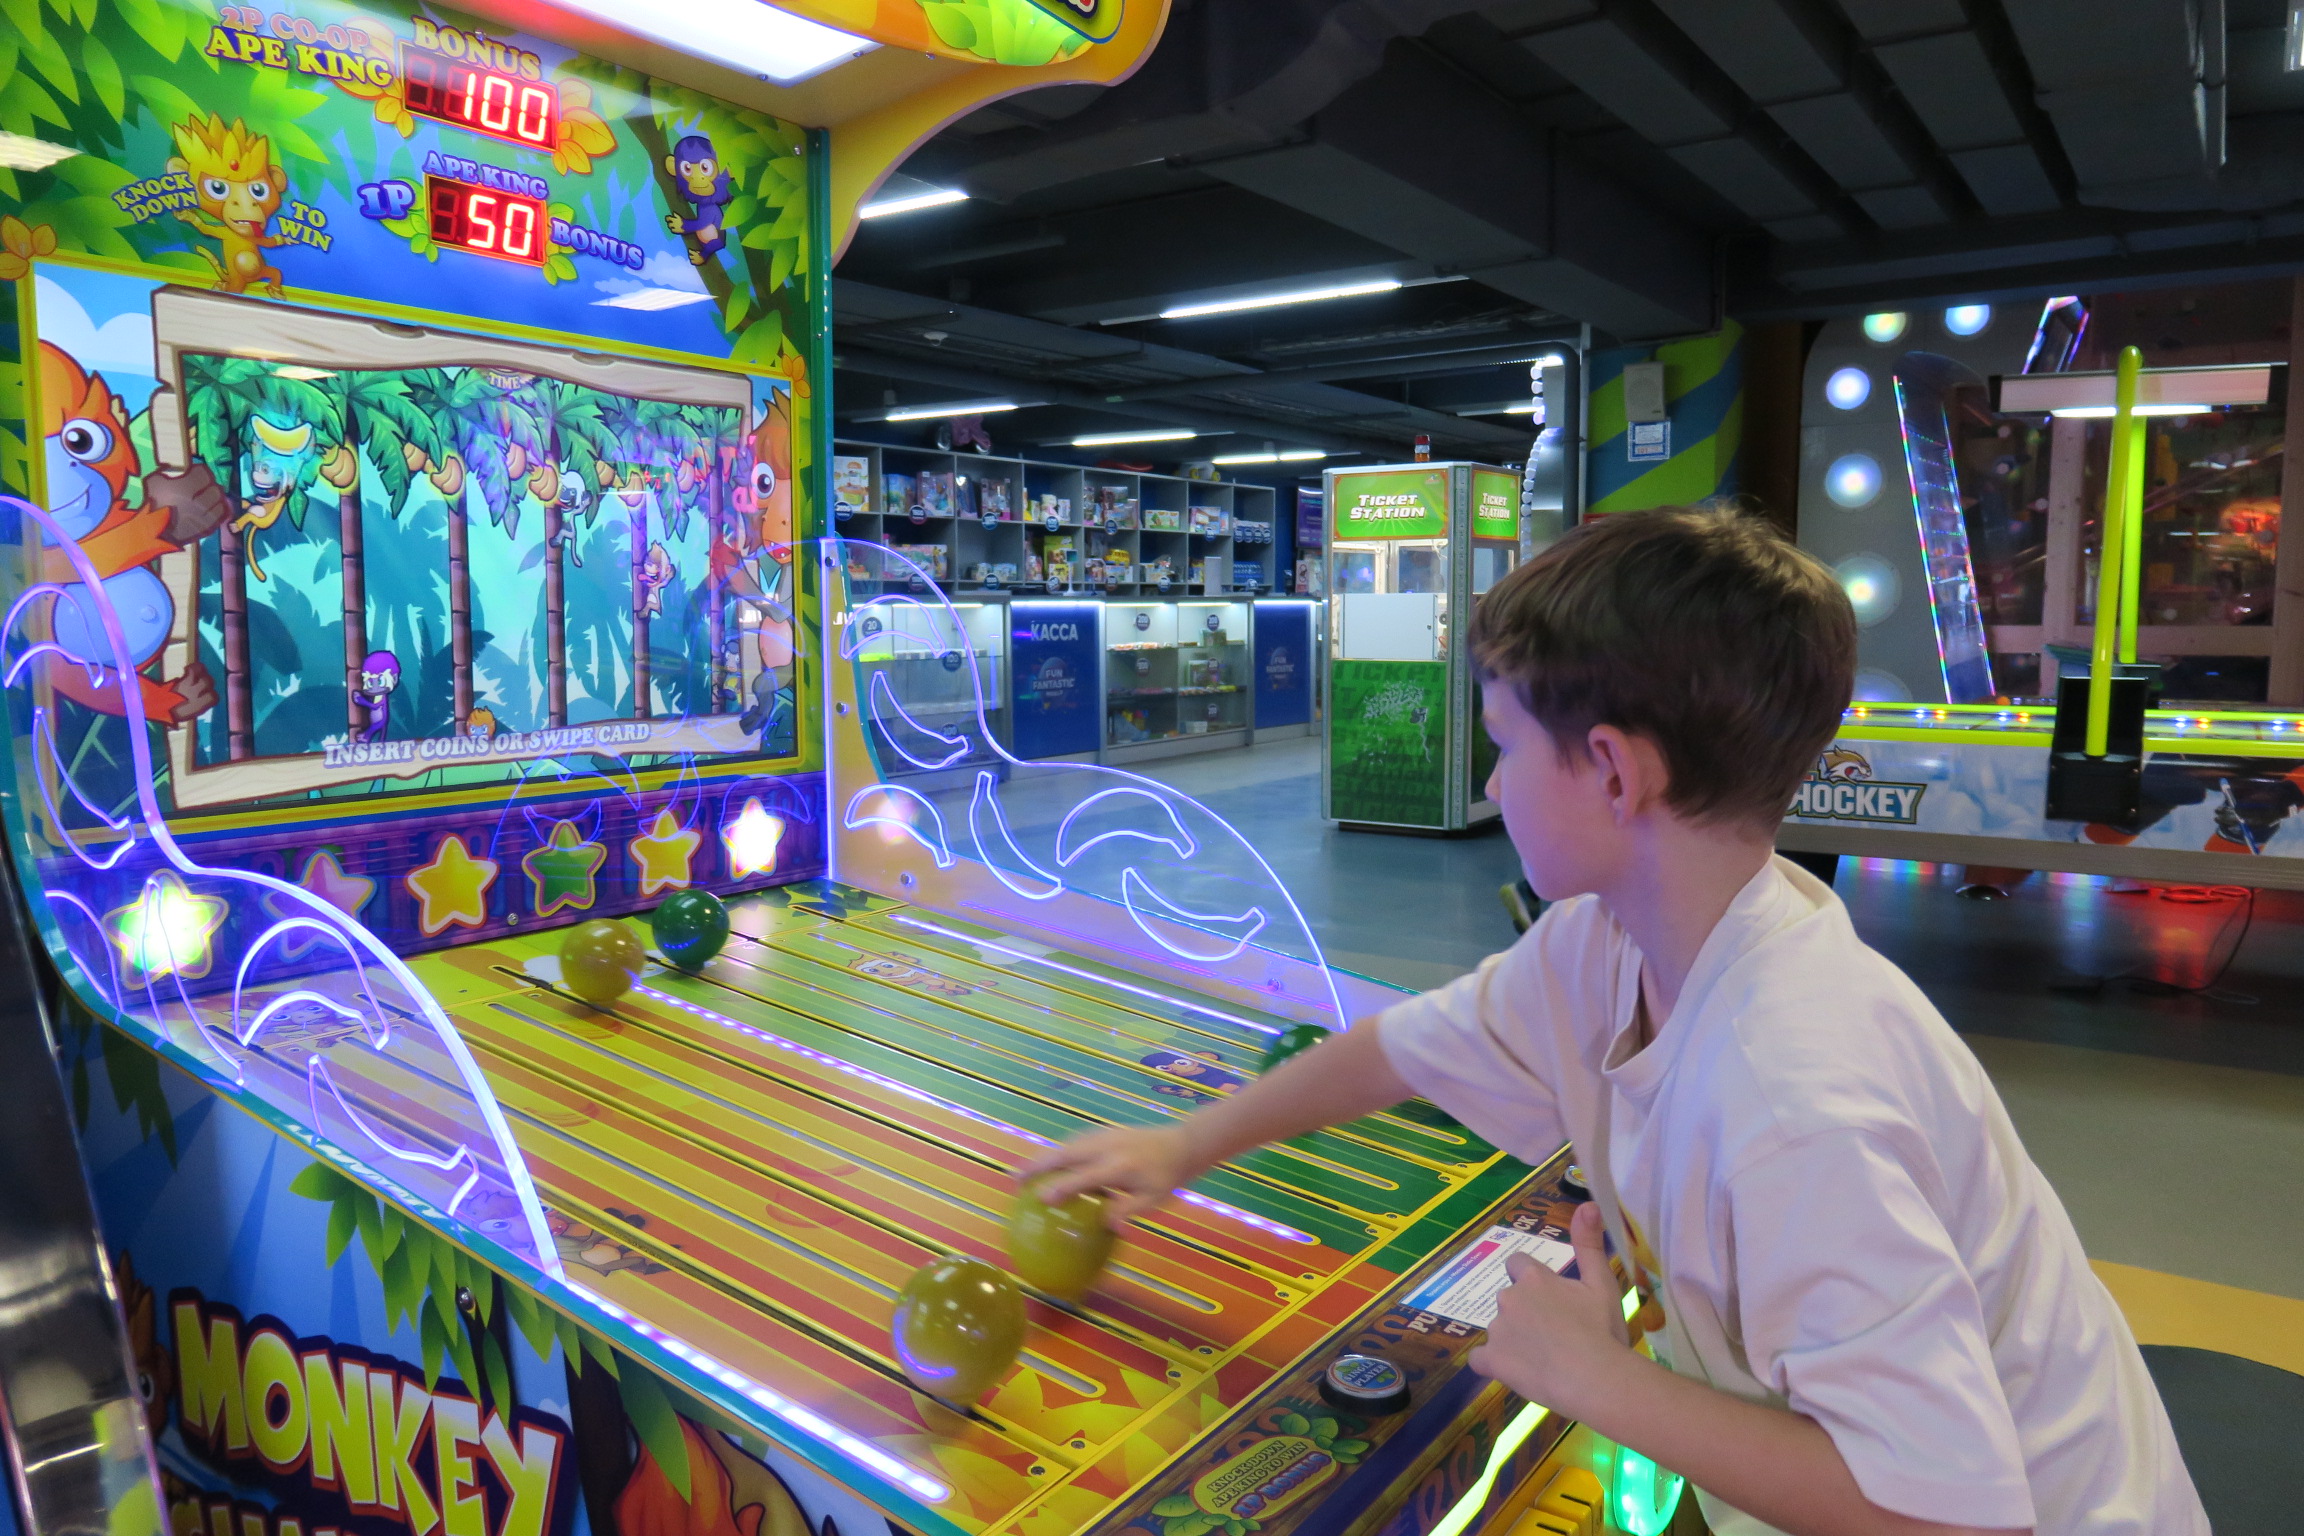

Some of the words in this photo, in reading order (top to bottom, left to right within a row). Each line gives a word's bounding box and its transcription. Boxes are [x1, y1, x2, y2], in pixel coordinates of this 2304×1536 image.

[220, 6, 264, 34] 2P
[270, 13, 370, 53] CO-OP
[411, 15, 542, 81] BONUS
[205, 26, 288, 69] APE
[297, 44, 393, 88] KING
[464, 71, 550, 143] 100
[113, 172, 194, 210] KNOCK
[424, 151, 478, 184] APE
[482, 164, 548, 200] KING
[130, 190, 199, 222] DOWN
[291, 201, 327, 229] TO
[468, 194, 534, 256] 50
[278, 216, 332, 253] WIN
[551, 217, 644, 270] BONUS
[1033, 679, 1075, 690] FANTASTIC
[1046, 669, 1063, 678] FUN
[324, 739, 414, 768] INSERT
[420, 735, 489, 760] COINS
[494, 732, 524, 753] OR
[528, 726, 593, 752] SWIPE
[598, 722, 650, 744] CARD
[1789, 783, 1918, 819] HOCKEY
[1343, 1360, 1376, 1382] SINGLE
[1355, 1364, 1388, 1387] PLAYER
[173, 1301, 564, 1536] MONKEY
[1207, 1463, 1251, 1493] KNOCK
[1249, 1440, 1287, 1467] DOWN
[1212, 1488, 1237, 1507] APE
[1235, 1469, 1268, 1494] KING
[1265, 1458, 1284, 1472] TO
[1282, 1441, 1308, 1465] WIN
[1255, 1451, 1332, 1499] BONUS
